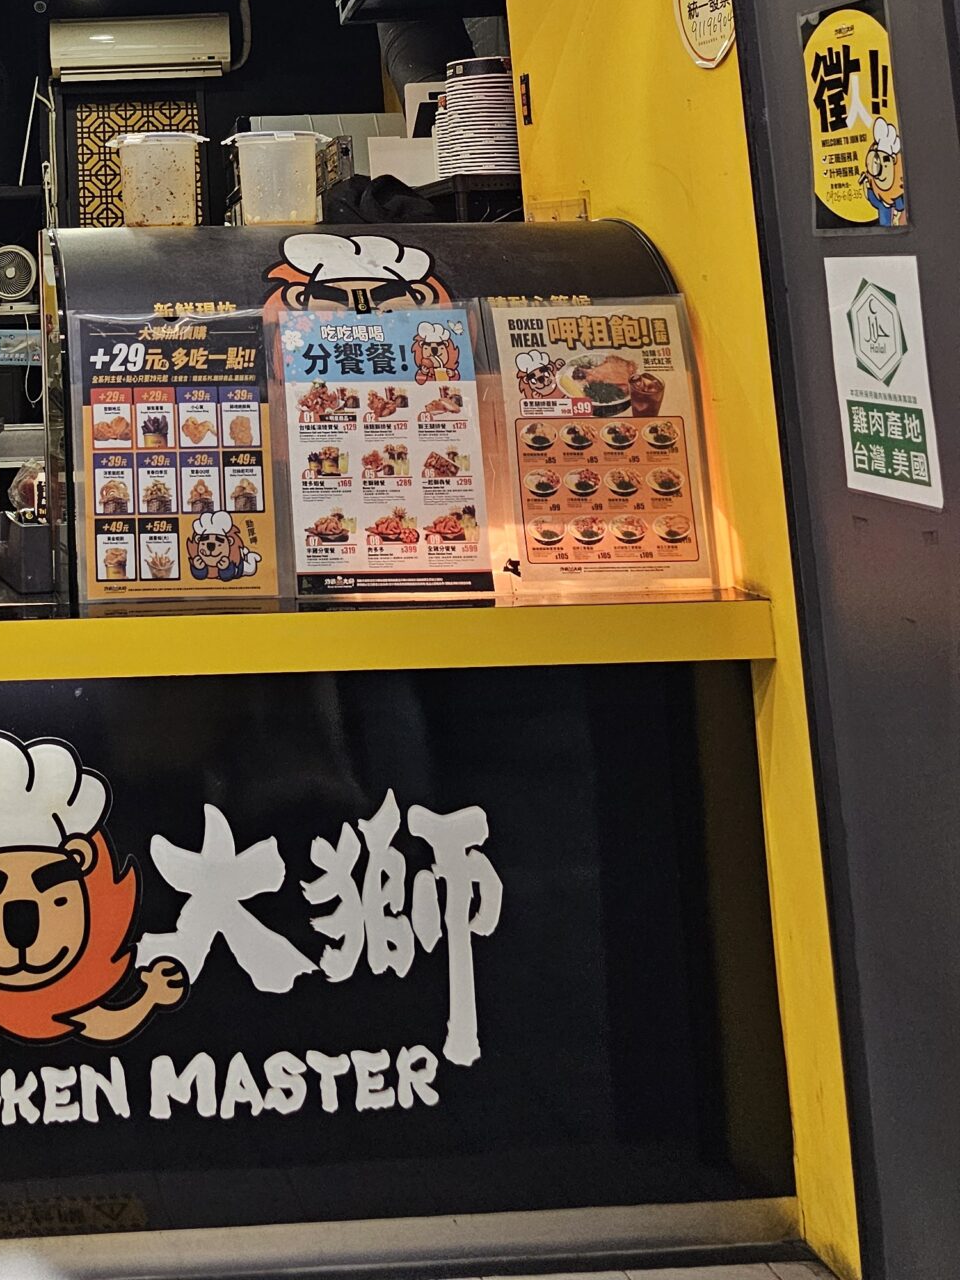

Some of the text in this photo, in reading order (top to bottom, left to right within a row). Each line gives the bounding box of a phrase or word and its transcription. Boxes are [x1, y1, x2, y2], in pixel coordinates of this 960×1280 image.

[821, 137, 843, 147] WELCOME
[508, 319, 543, 331] BOXED
[320, 324, 385, 342] 吃吃喝喝
[547, 315, 653, 350] 呷粗飽!
[510, 333, 547, 348] MEAL
[869, 344, 887, 354] Halal
[171, 346, 256, 370] 多吃一點!!
[302, 343, 409, 376] 分饗餐!
[98, 389, 125, 402] +29元
[141, 389, 168, 401] +29元
[184, 388, 211, 401] +39元
[227, 388, 253, 401] +39元
[573, 402, 592, 415] $99
[303, 412, 314, 422] 01
[366, 413, 376, 422] 02
[420, 412, 430, 421] 03
[343, 423, 357, 431] $129
[393, 422, 408, 430] $129
[452, 422, 467, 430] $129
[852, 406, 922, 443] 雞肉產地
[101, 455, 128, 467] +39元
[144, 454, 171, 467] +39元
[187, 454, 214, 467] +39元
[230, 453, 256, 465] +49元
[337, 479, 352, 487] $169
[396, 478, 412, 487] $289
[102, 521, 129, 533] +49元
[145, 520, 173, 533] +59元
[341, 546, 357, 555] $319
[149, 1045, 440, 1120] MASTER
